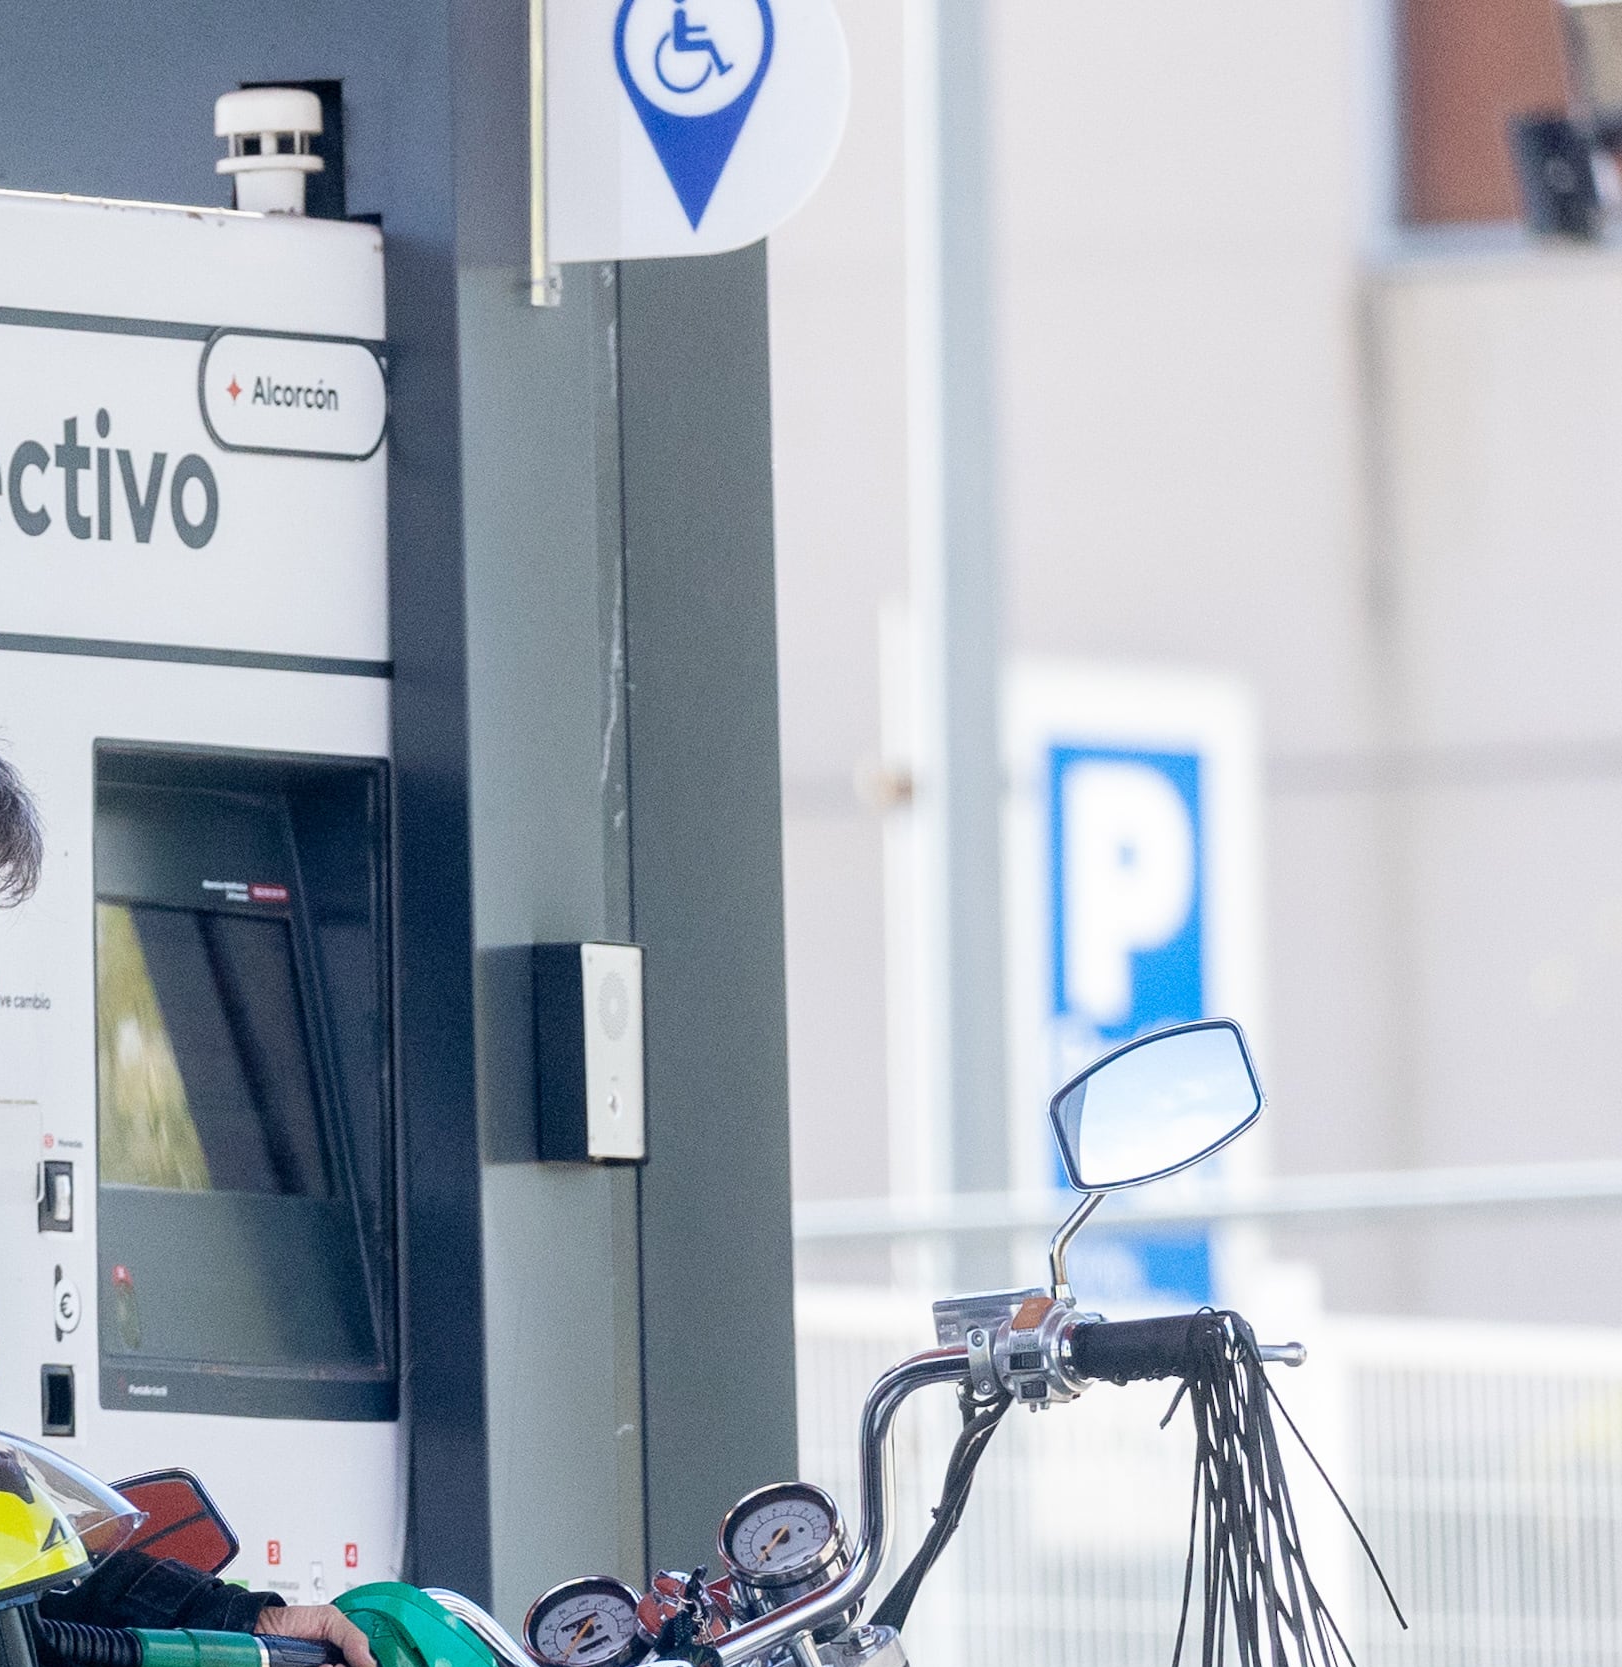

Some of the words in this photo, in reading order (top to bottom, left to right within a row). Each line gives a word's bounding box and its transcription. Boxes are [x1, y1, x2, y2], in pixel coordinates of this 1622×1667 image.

[251, 377, 341, 413] Alcorcón
[1060, 760, 1195, 1019] P
[13, 993, 52, 1010] cambio
[59, 1291, 74, 1319] €
